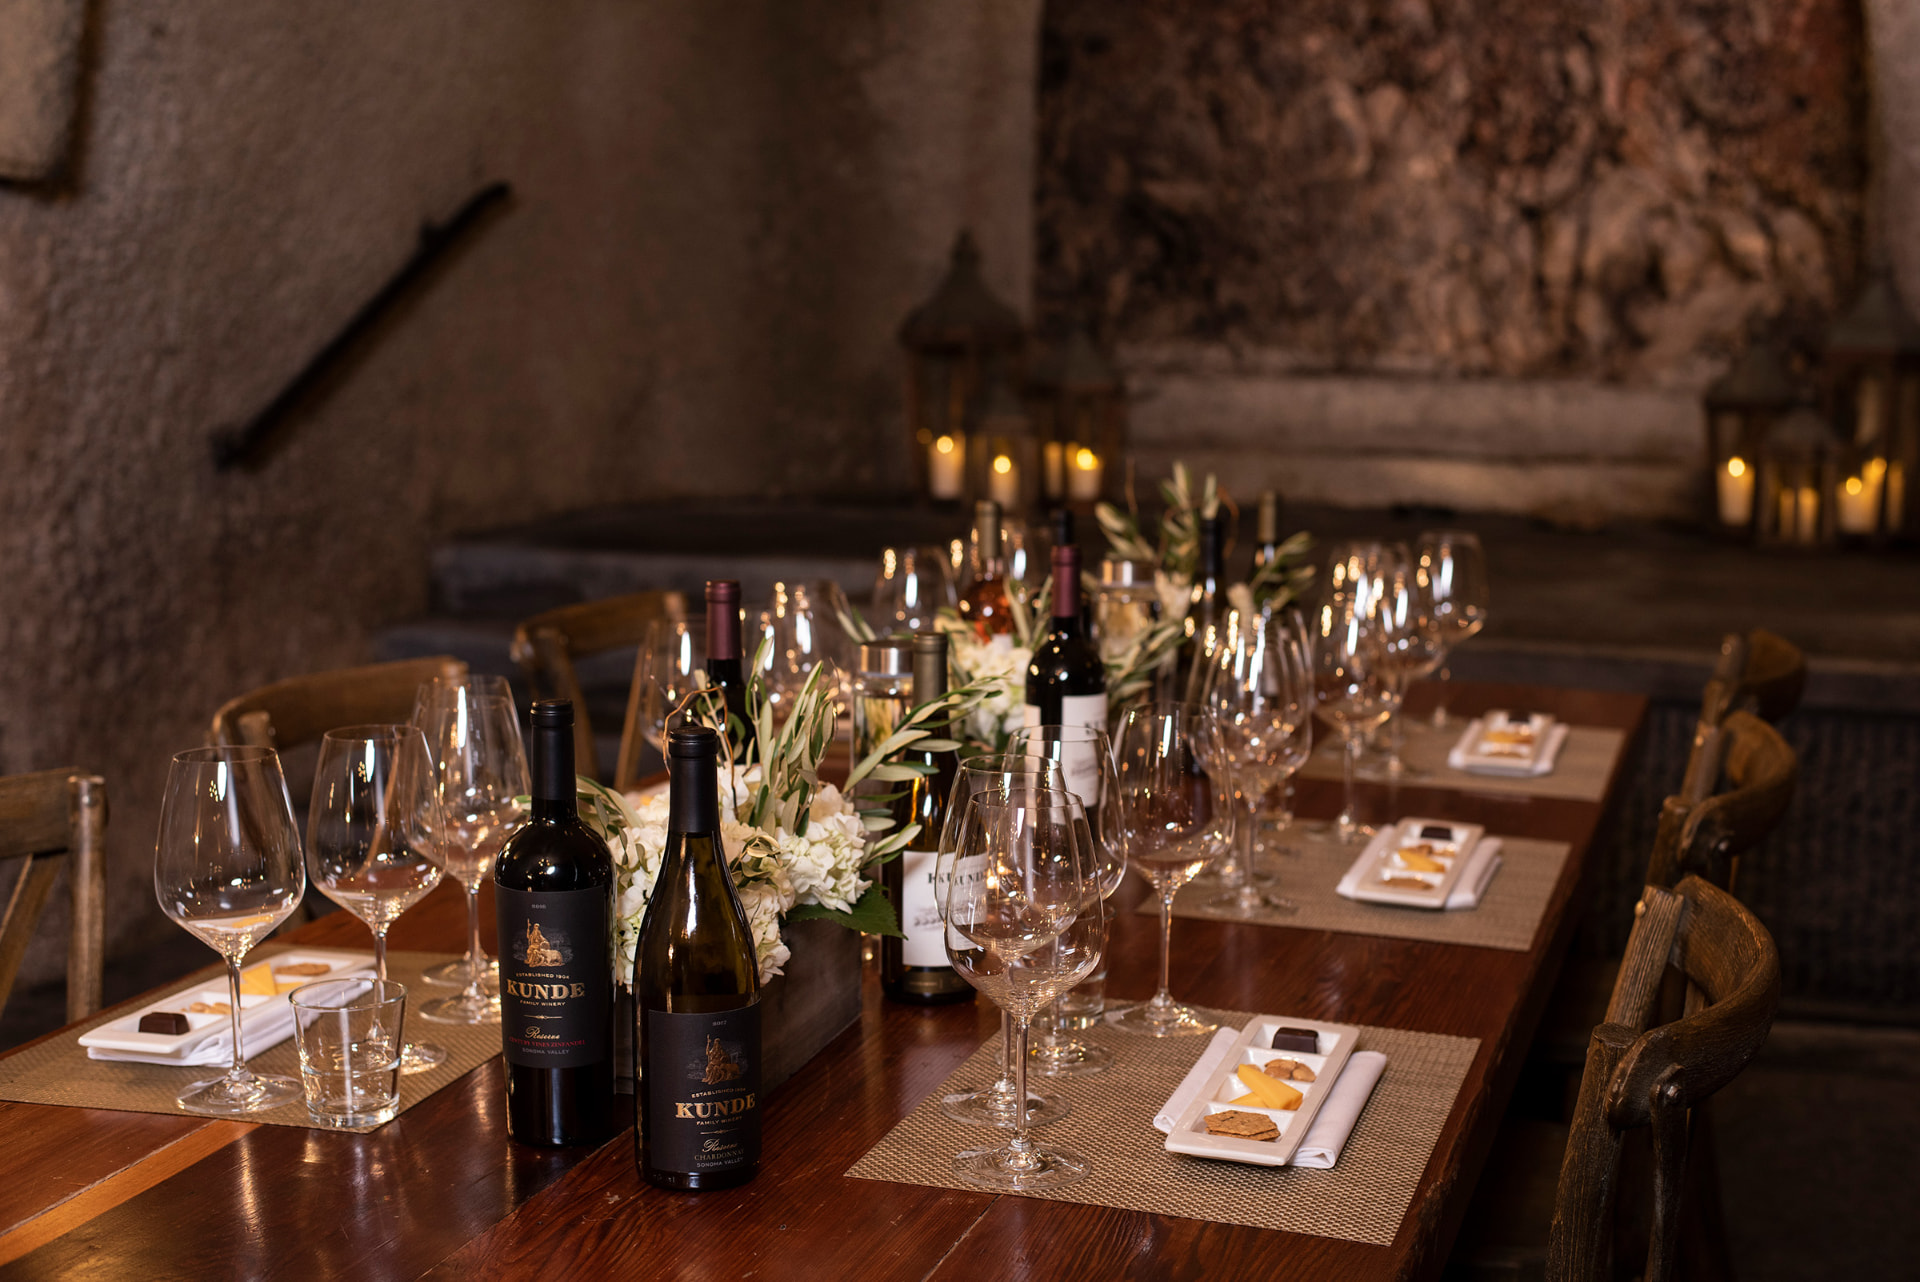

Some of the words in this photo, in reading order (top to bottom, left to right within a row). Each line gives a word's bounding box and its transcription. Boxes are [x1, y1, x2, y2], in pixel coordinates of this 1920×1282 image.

[506, 979, 585, 999] KUNDE
[525, 1026, 560, 1039] Reserve
[522, 1047, 546, 1055] SONOMA
[691, 1088, 734, 1099] ESTABLISHED
[675, 1093, 756, 1118] KUNDE
